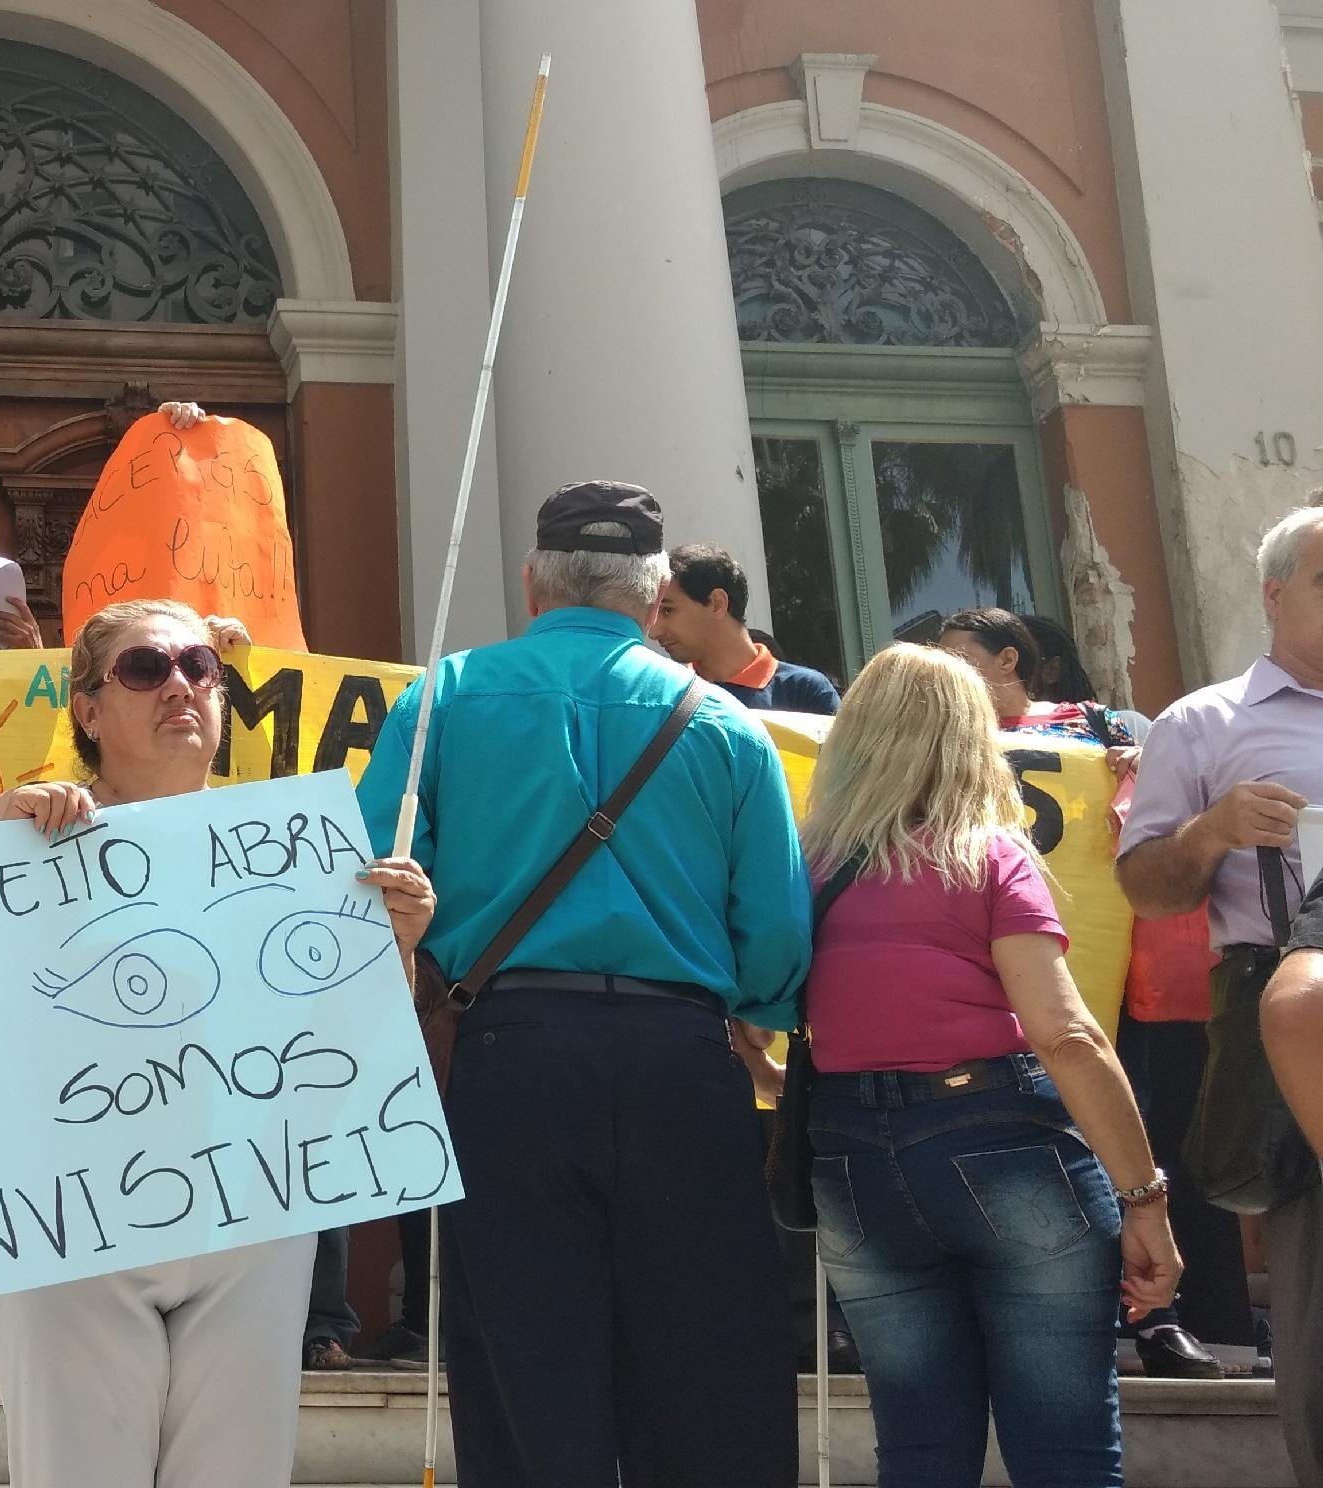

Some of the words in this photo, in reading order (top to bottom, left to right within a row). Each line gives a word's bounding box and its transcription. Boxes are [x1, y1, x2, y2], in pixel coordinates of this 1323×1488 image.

[1253, 430, 1297, 468] 10
[75, 562, 146, 604] na
[207, 811, 368, 888] ABRA
[53, 1030, 359, 1124] SOMOS
